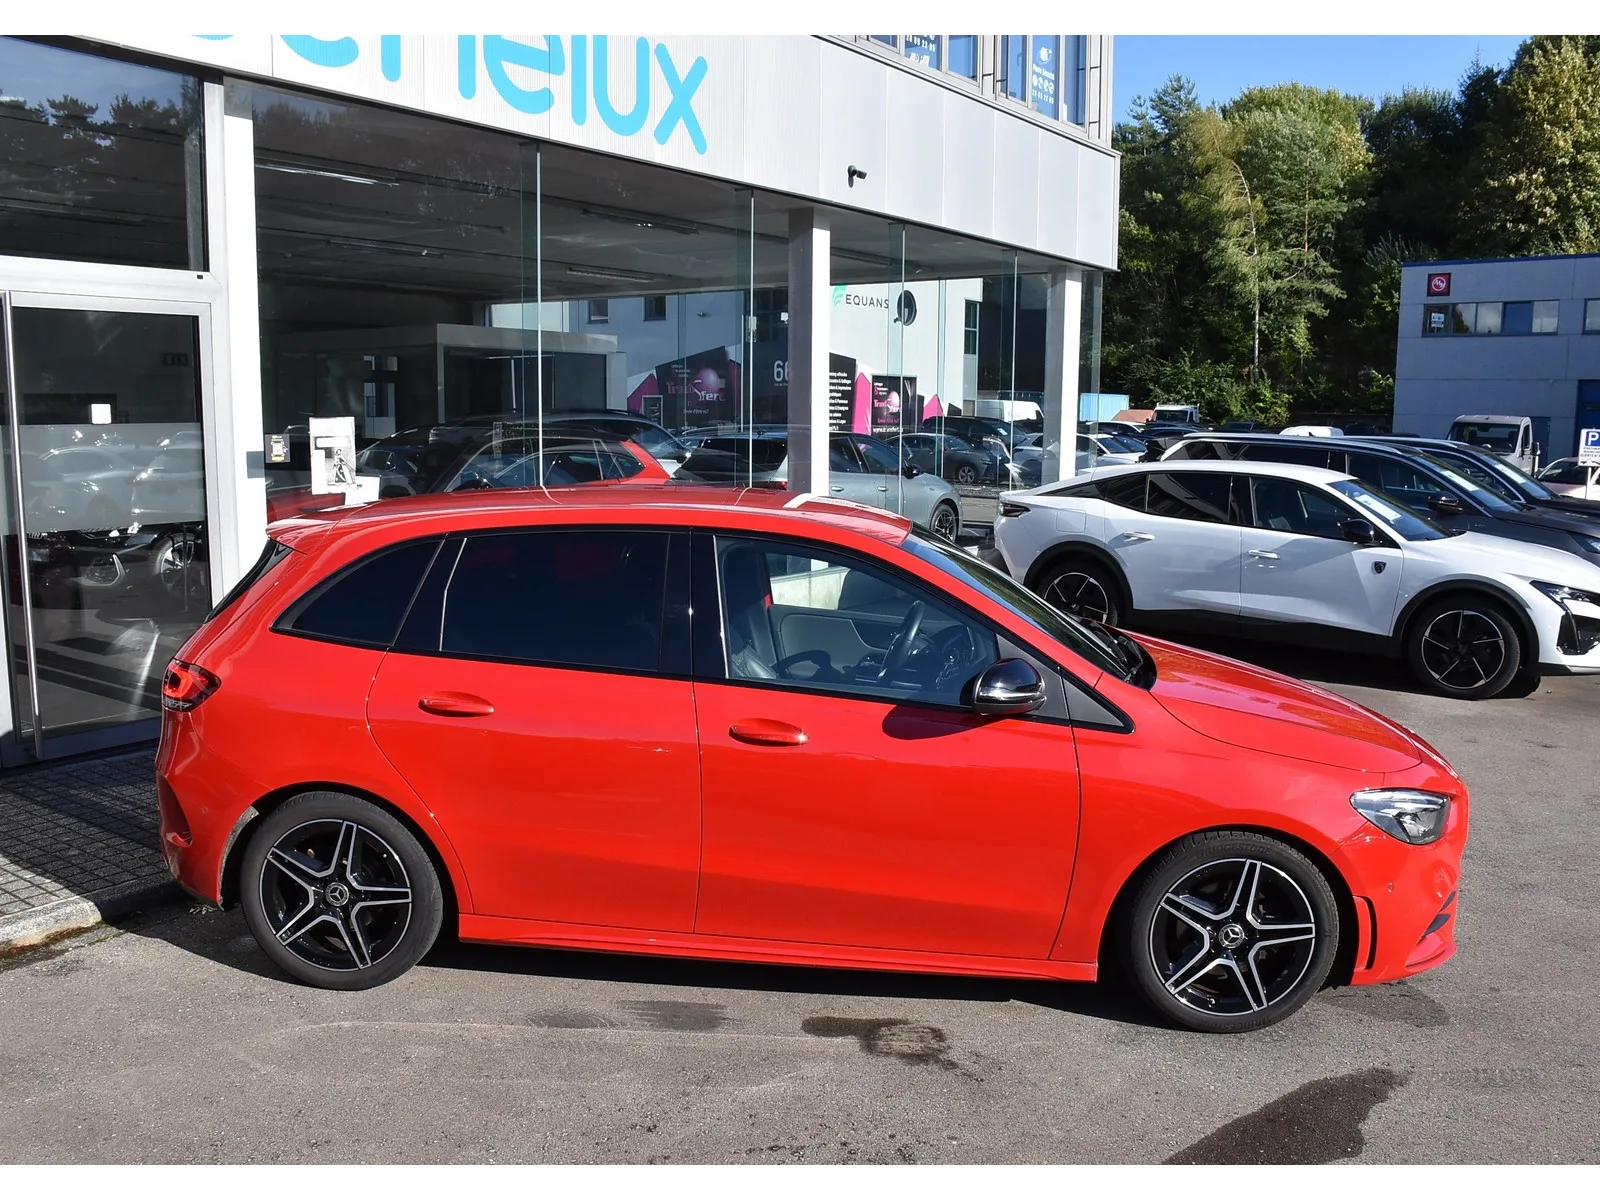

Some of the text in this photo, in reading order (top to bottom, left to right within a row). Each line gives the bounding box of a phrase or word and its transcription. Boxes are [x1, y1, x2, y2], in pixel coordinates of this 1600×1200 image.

[192, 35, 708, 155] elux
[845, 293, 889, 309] EQUANS
[1587, 432, 1599, 446] P
